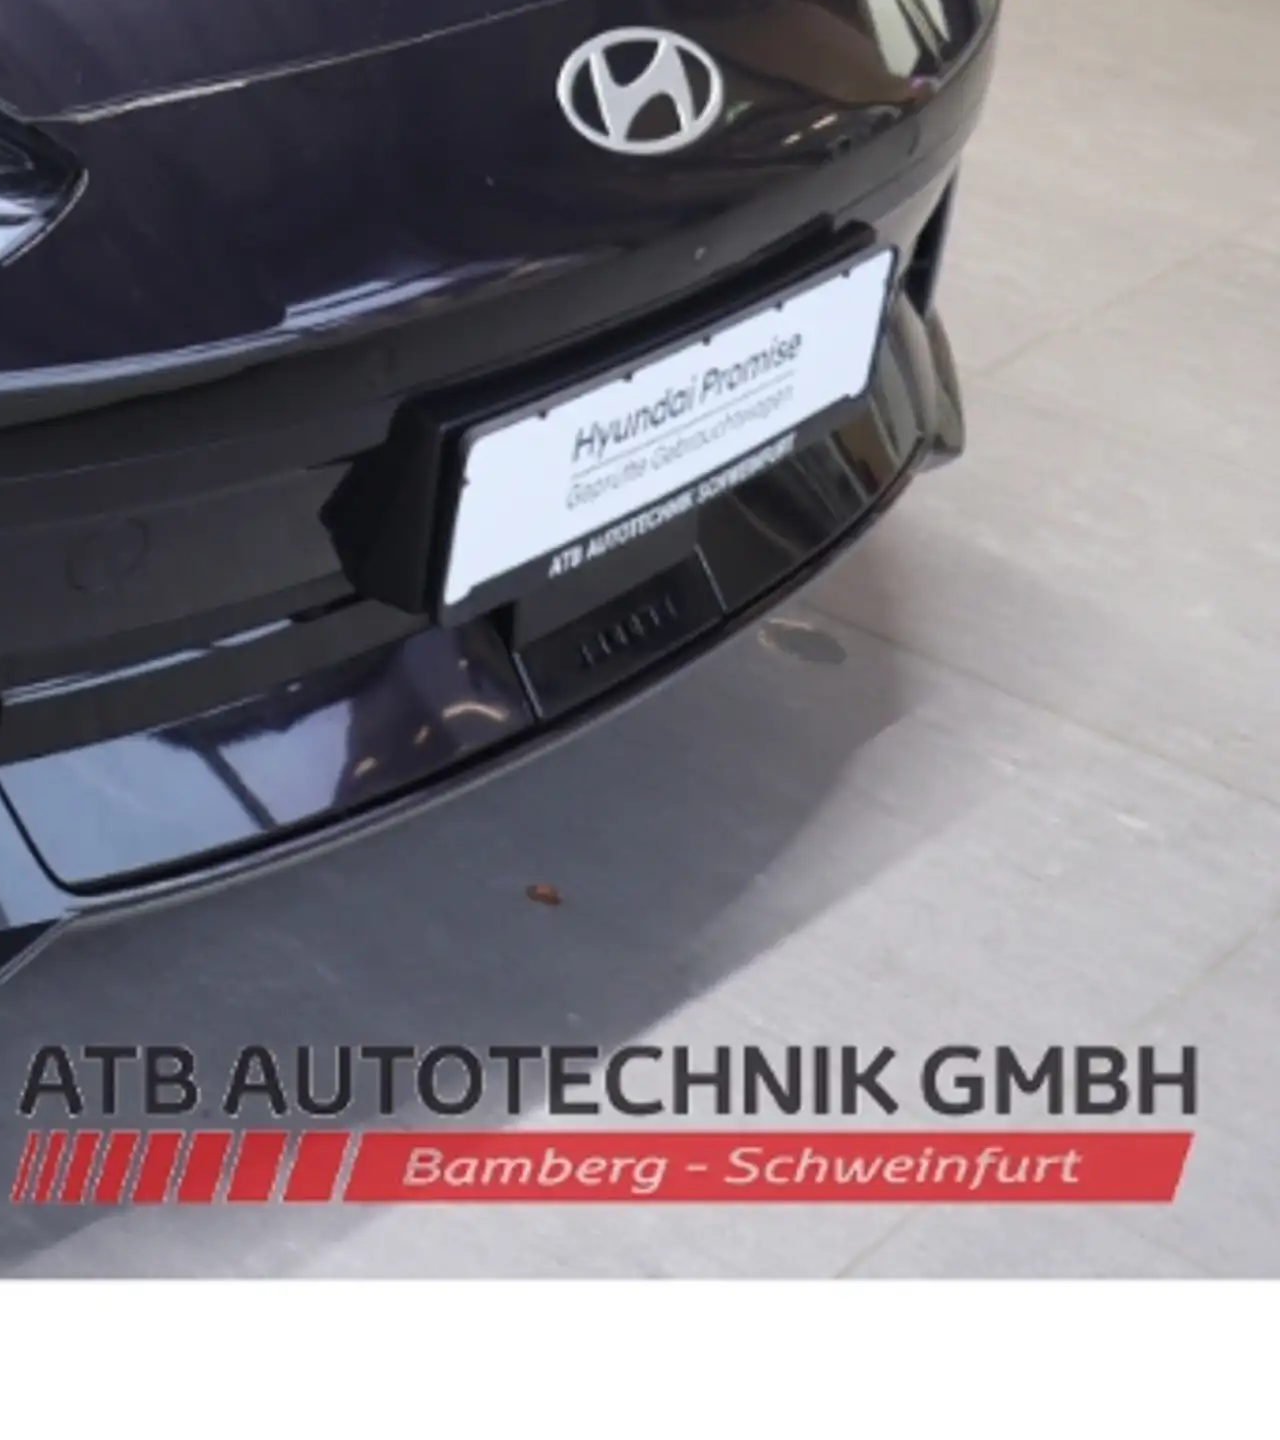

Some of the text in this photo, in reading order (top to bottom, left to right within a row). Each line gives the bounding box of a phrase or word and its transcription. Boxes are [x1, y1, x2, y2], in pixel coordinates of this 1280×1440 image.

[571, 333, 802, 462] Hyundai Promise
[548, 544, 584, 579] ATB
